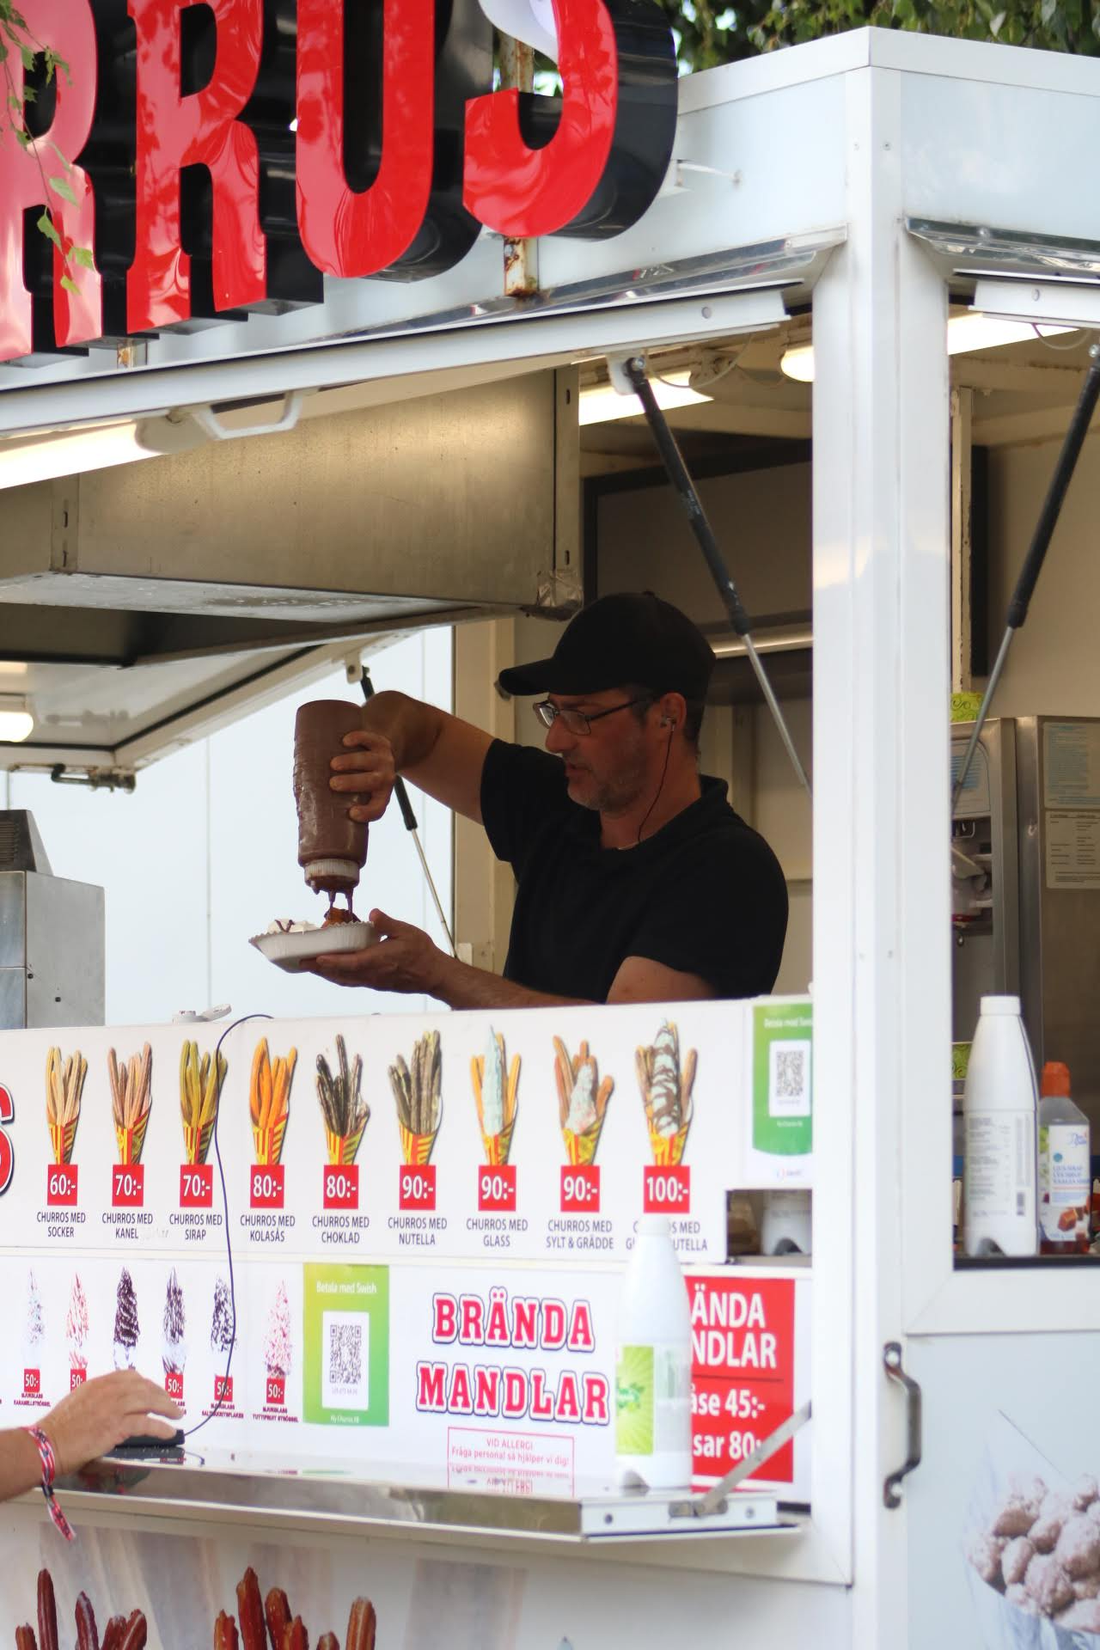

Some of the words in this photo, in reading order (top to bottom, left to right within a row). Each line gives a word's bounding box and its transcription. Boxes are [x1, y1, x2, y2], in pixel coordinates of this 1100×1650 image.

[50, 1174, 76, 1196] 60:-
[115, 1175, 142, 1197] 70:-
[183, 1175, 211, 1197] 70:-
[253, 1175, 282, 1198] 80:-
[326, 1175, 357, 1198] 80:-
[402, 1175, 434, 1199] 90:-
[481, 1176, 514, 1200] 90:-
[564, 1176, 597, 1201] 90:-
[647, 1176, 689, 1202] 100:-
[37, 1212, 69, 1223] CHURROS
[69, 1212, 86, 1224] MED
[102, 1213, 136, 1224] CHURROS
[136, 1213, 153, 1225] MED
[169, 1213, 204, 1225] CHURROS
[204, 1214, 223, 1225] MED
[240, 1214, 276, 1226] CHURROS
[277, 1214, 295, 1226] MED
[312, 1215, 350, 1227] CHURROS
[351, 1216, 369, 1228] MED
[388, 1216, 428, 1228] CHURROS
[427, 1217, 447, 1229] MED
[466, 1218, 507, 1230] CHURROS
[508, 1219, 528, 1231] MED
[47, 1226, 74, 1238] SOCKER
[548, 1219, 589, 1232] CHURROS
[591, 1220, 613, 1232] MED
[680, 1222, 700, 1234] MED
[115, 1228, 139, 1239] KANEL
[185, 1228, 207, 1240] SIRAP
[250, 1229, 285, 1242] KOLASÅS
[321, 1231, 360, 1244] CHOKLAD
[399, 1232, 435, 1245] NUTELLA
[483, 1234, 510, 1247] GLASS
[546, 1236, 566, 1248] SYLT
[568, 1236, 575, 1248] &
[673, 1238, 708, 1251] UTELLA
[316, 1280, 338, 1293] Betala
[340, 1282, 355, 1293] med
[357, 1281, 377, 1294] Swish
[691, 1283, 766, 1328] ÄNDA
[433, 1287, 595, 1352] BRÄNDA
[692, 1330, 777, 1369] NDLAR
[25, 1373, 40, 1387] 50:-
[168, 1378, 182, 1393] 50:-
[268, 1384, 283, 1399] 50:-
[416, 1361, 610, 1425] MANDLAR
[691, 1383, 721, 1416] åse
[725, 1388, 766, 1420] 45:-
[487, 1438, 499, 1447] VID
[693, 1432, 725, 1459] sar
